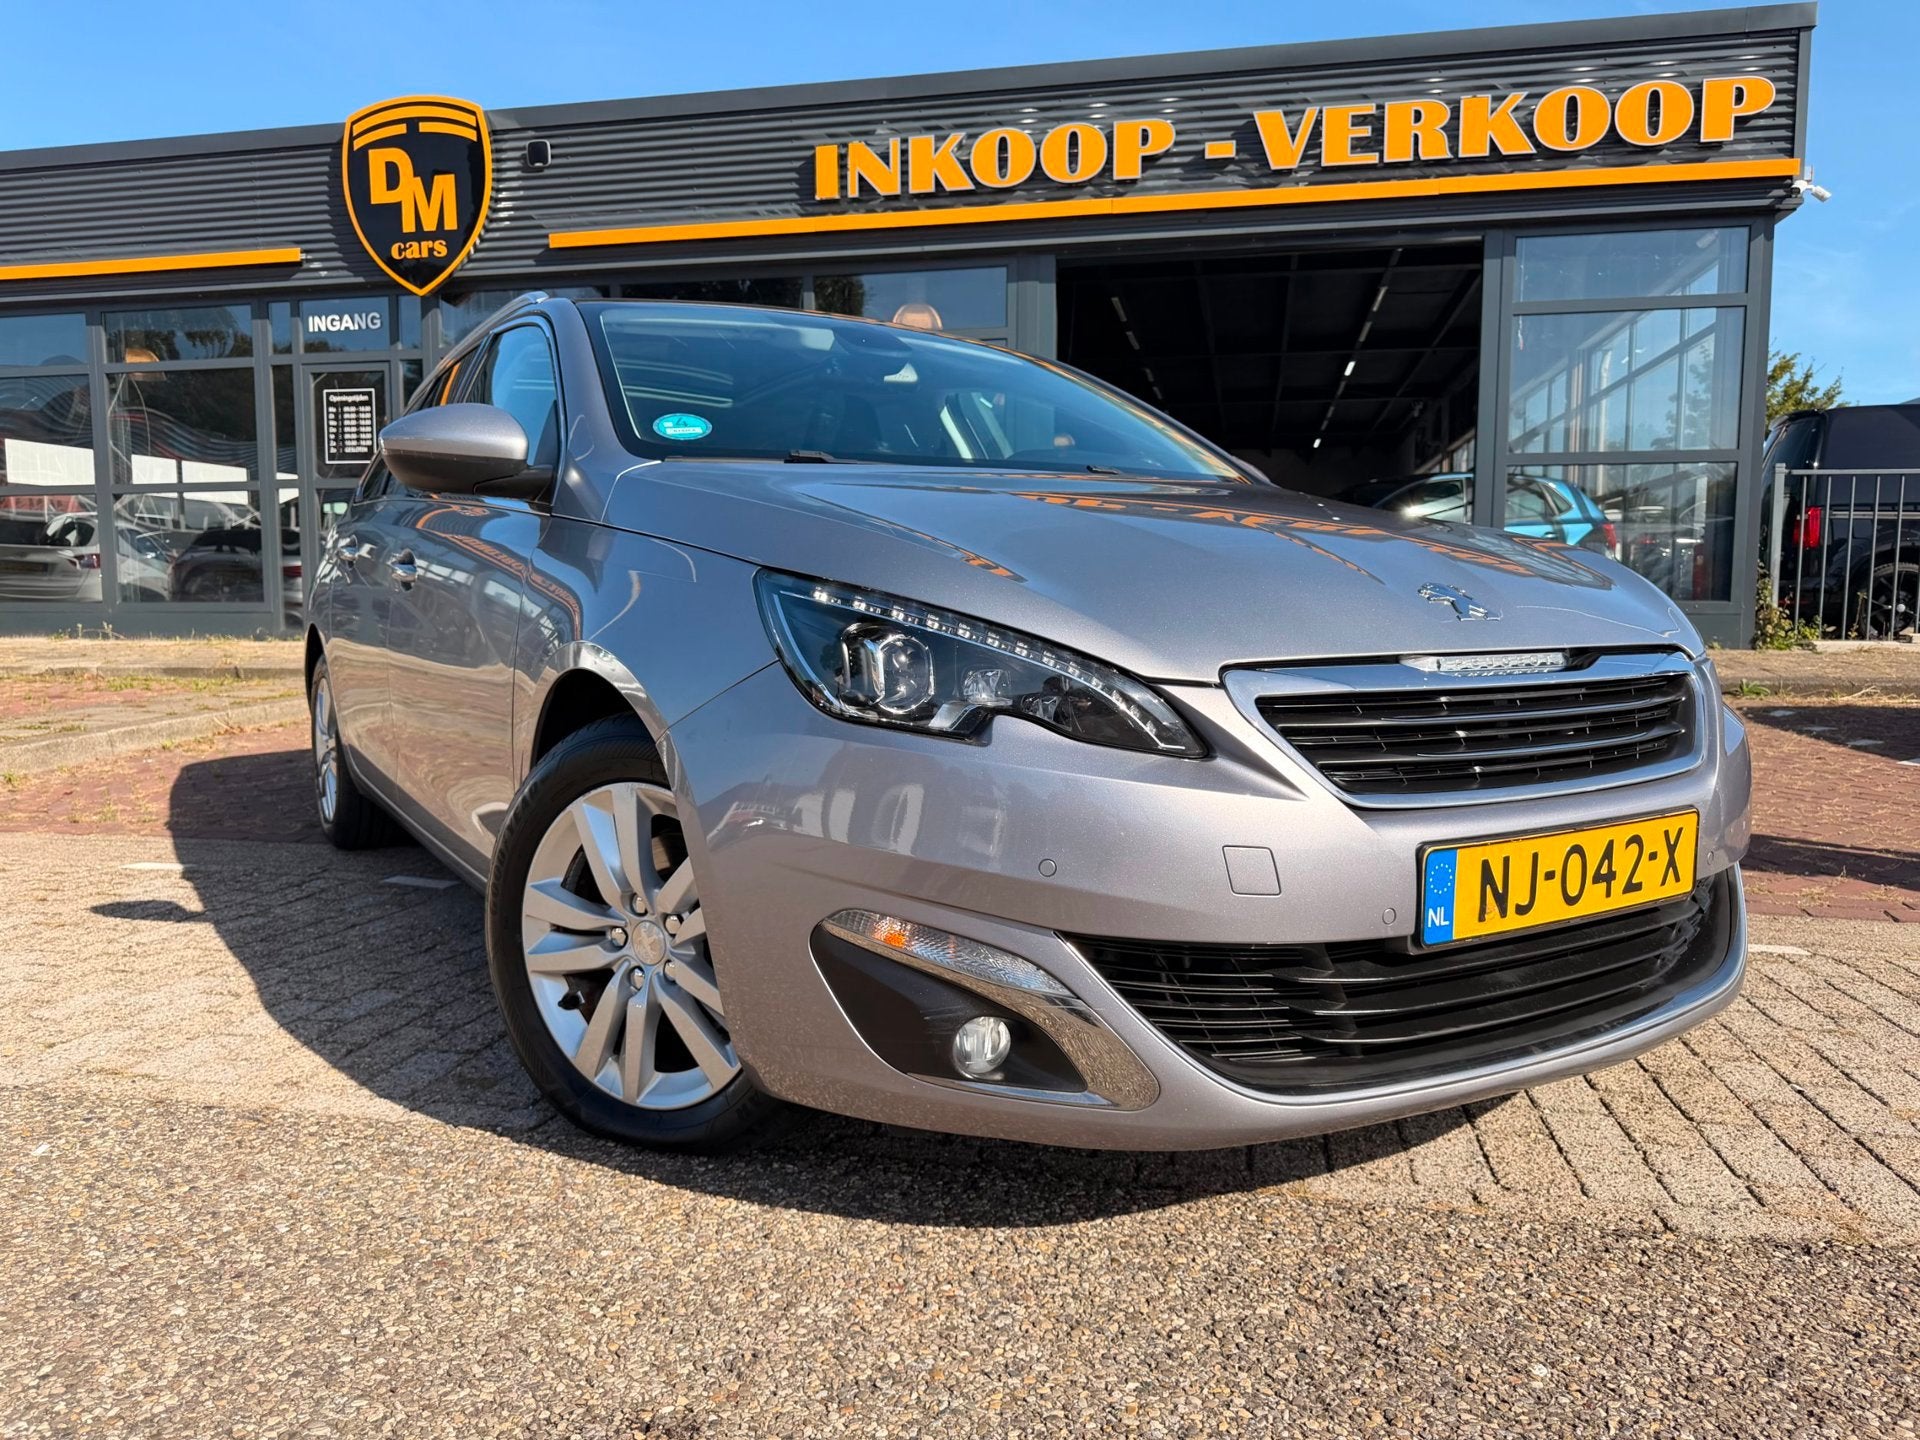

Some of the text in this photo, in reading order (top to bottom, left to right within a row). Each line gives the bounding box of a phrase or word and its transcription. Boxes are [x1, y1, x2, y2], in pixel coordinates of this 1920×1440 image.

[814, 118, 1176, 200] INKOOP
[1253, 75, 1776, 170] VERKOOP
[368, 147, 458, 233] DM
[391, 239, 448, 260] cars
[308, 312, 381, 333] INGANG
[1478, 827, 1684, 923] NJ-042-X
[1428, 907, 1449, 928] NL
